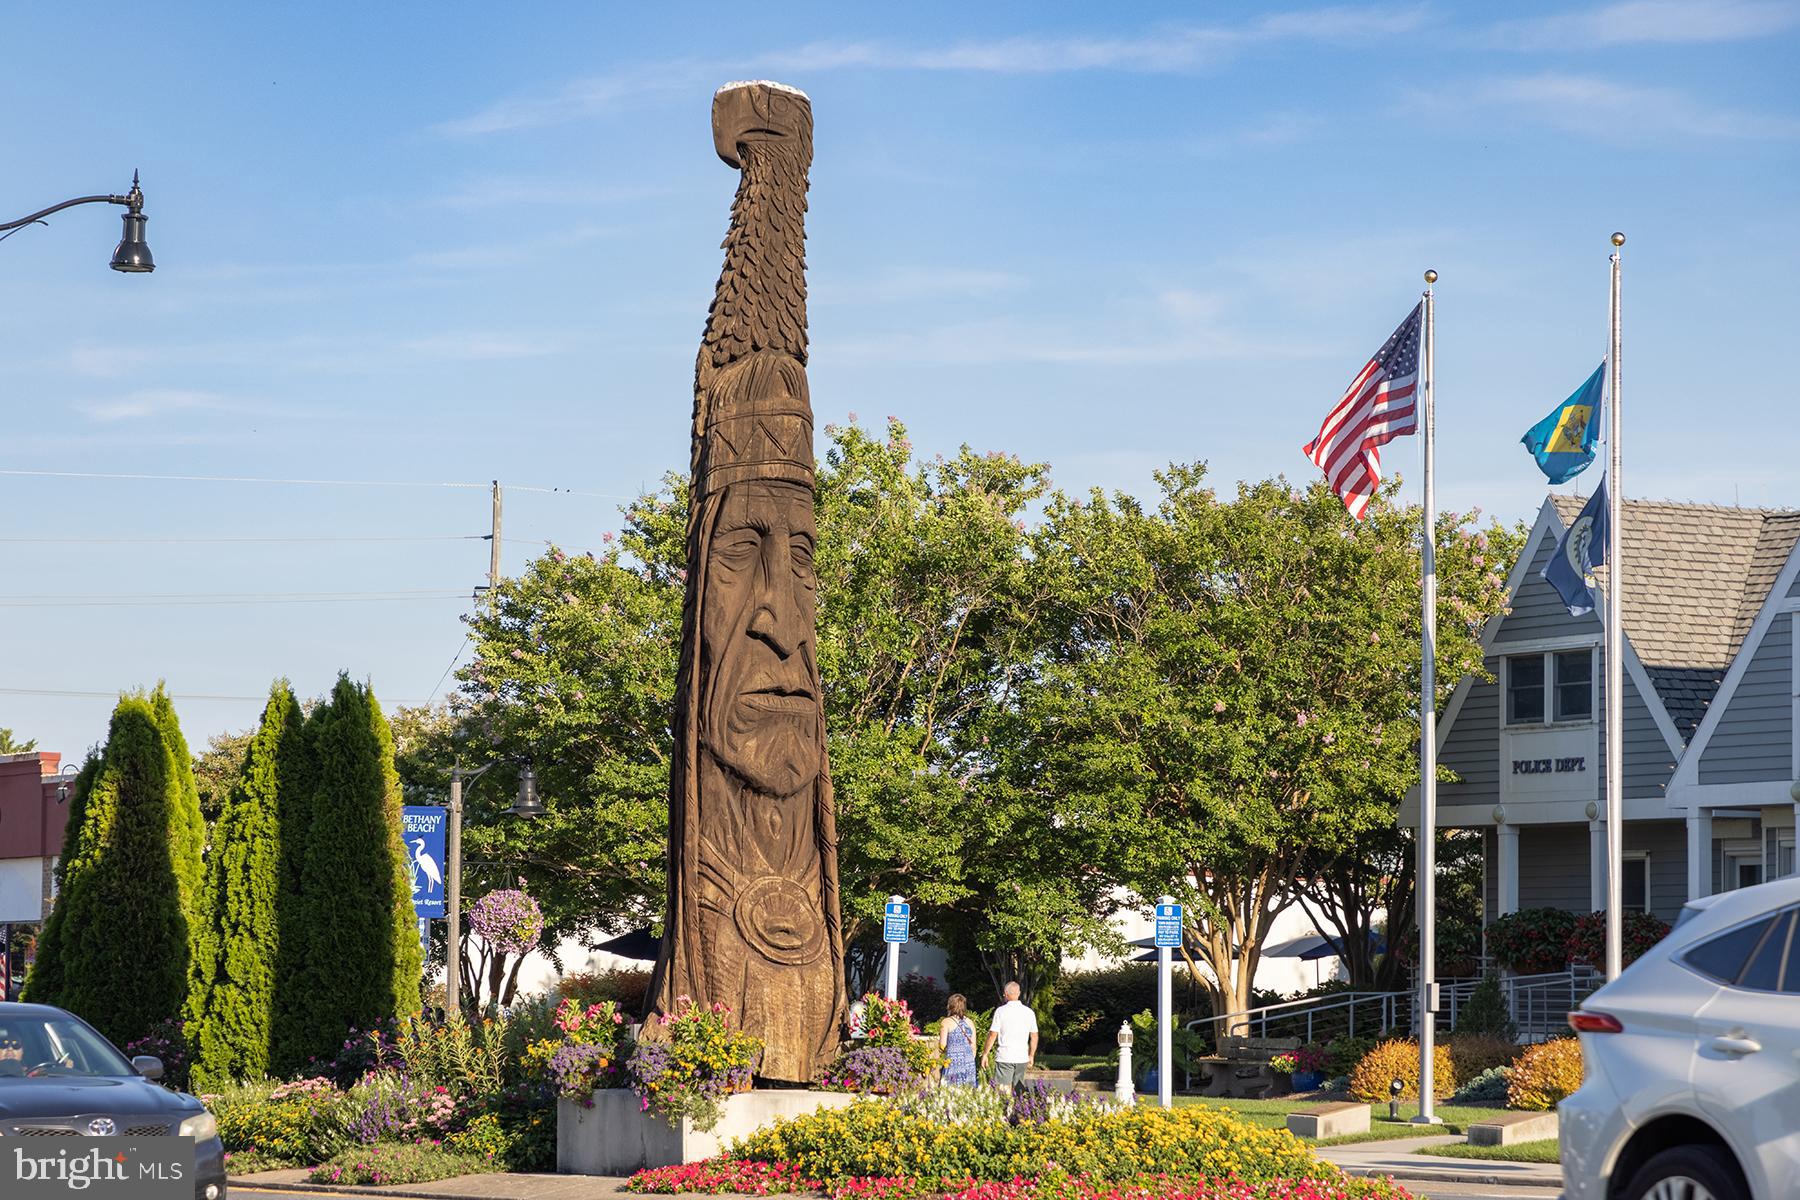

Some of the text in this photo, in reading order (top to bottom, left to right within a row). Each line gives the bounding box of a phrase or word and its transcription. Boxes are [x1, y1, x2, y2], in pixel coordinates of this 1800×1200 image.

[1512, 759, 1552, 774] POLICE
[403, 815, 441, 824] BETHANY
[407, 823, 435, 833] BEACH
